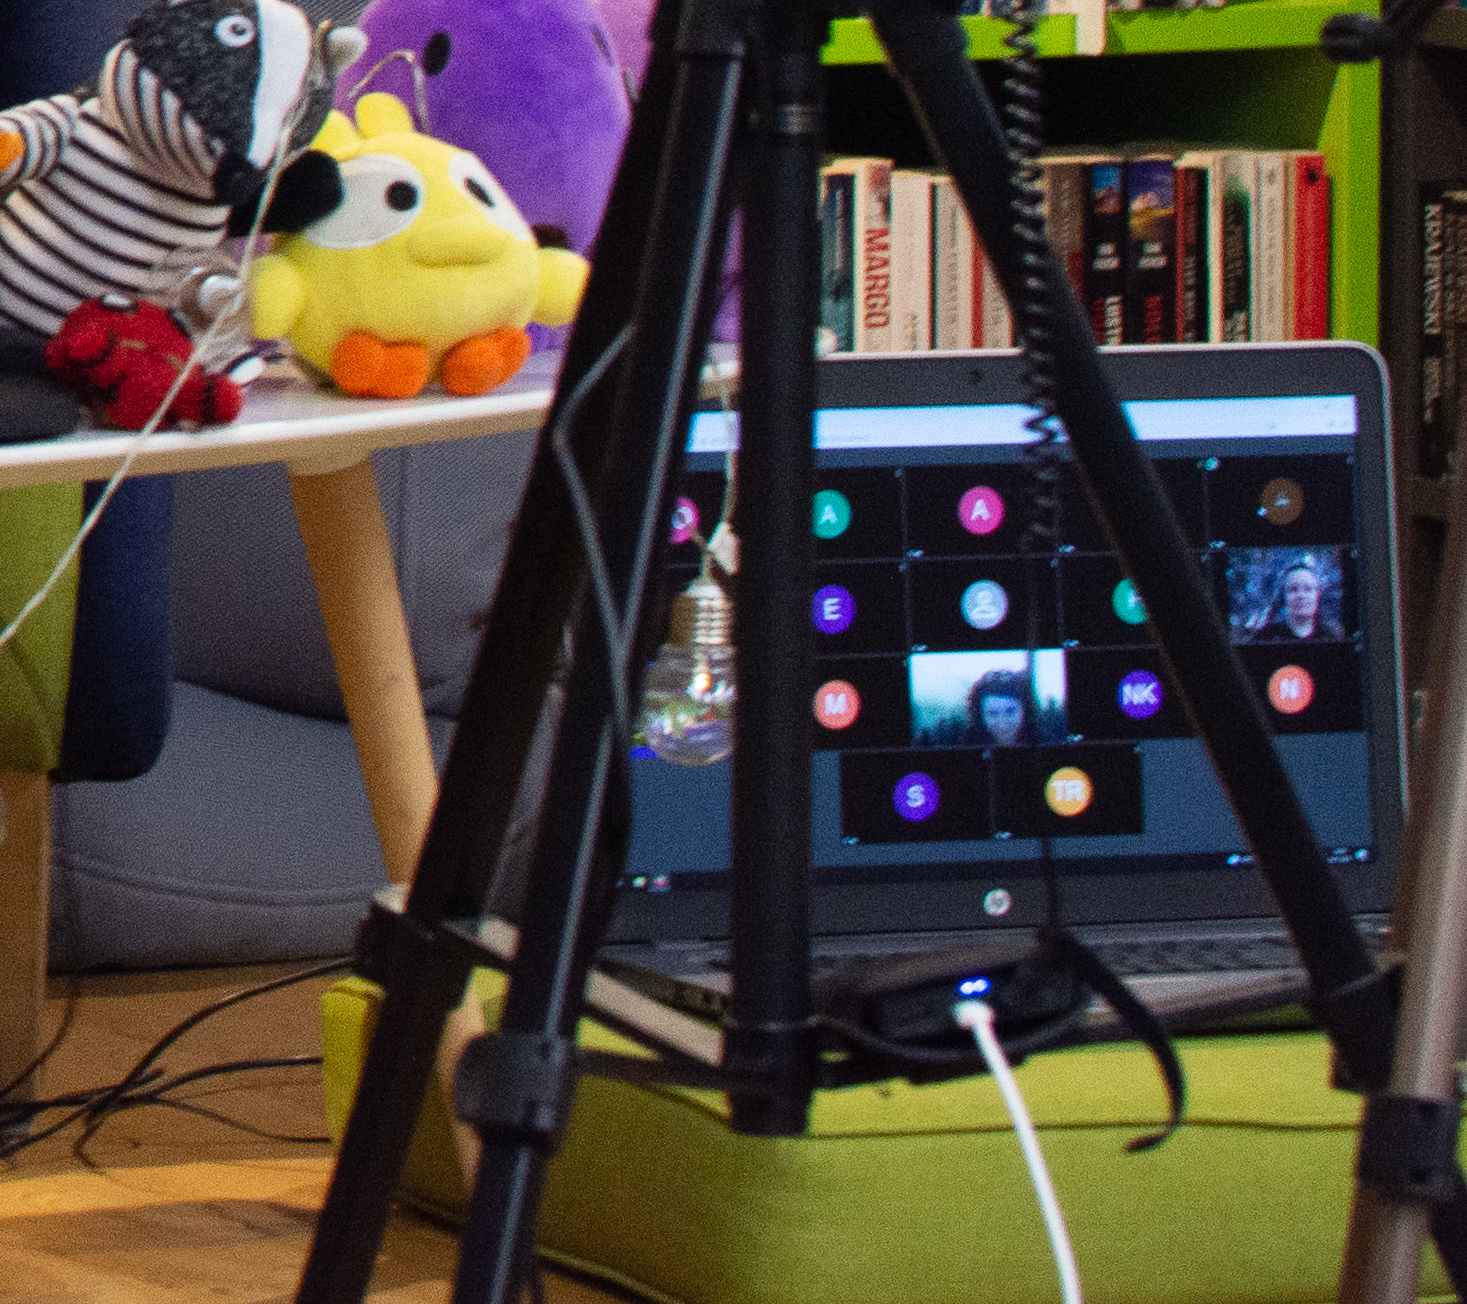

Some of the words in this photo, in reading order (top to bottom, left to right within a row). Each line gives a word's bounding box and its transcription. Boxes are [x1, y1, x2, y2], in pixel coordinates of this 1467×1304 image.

[863, 227, 890, 328] MARGO
[819, 502, 839, 526] A
[970, 498, 989, 522] A
[824, 597, 842, 621] E
[824, 693, 847, 716] M
[906, 784, 926, 808] S
